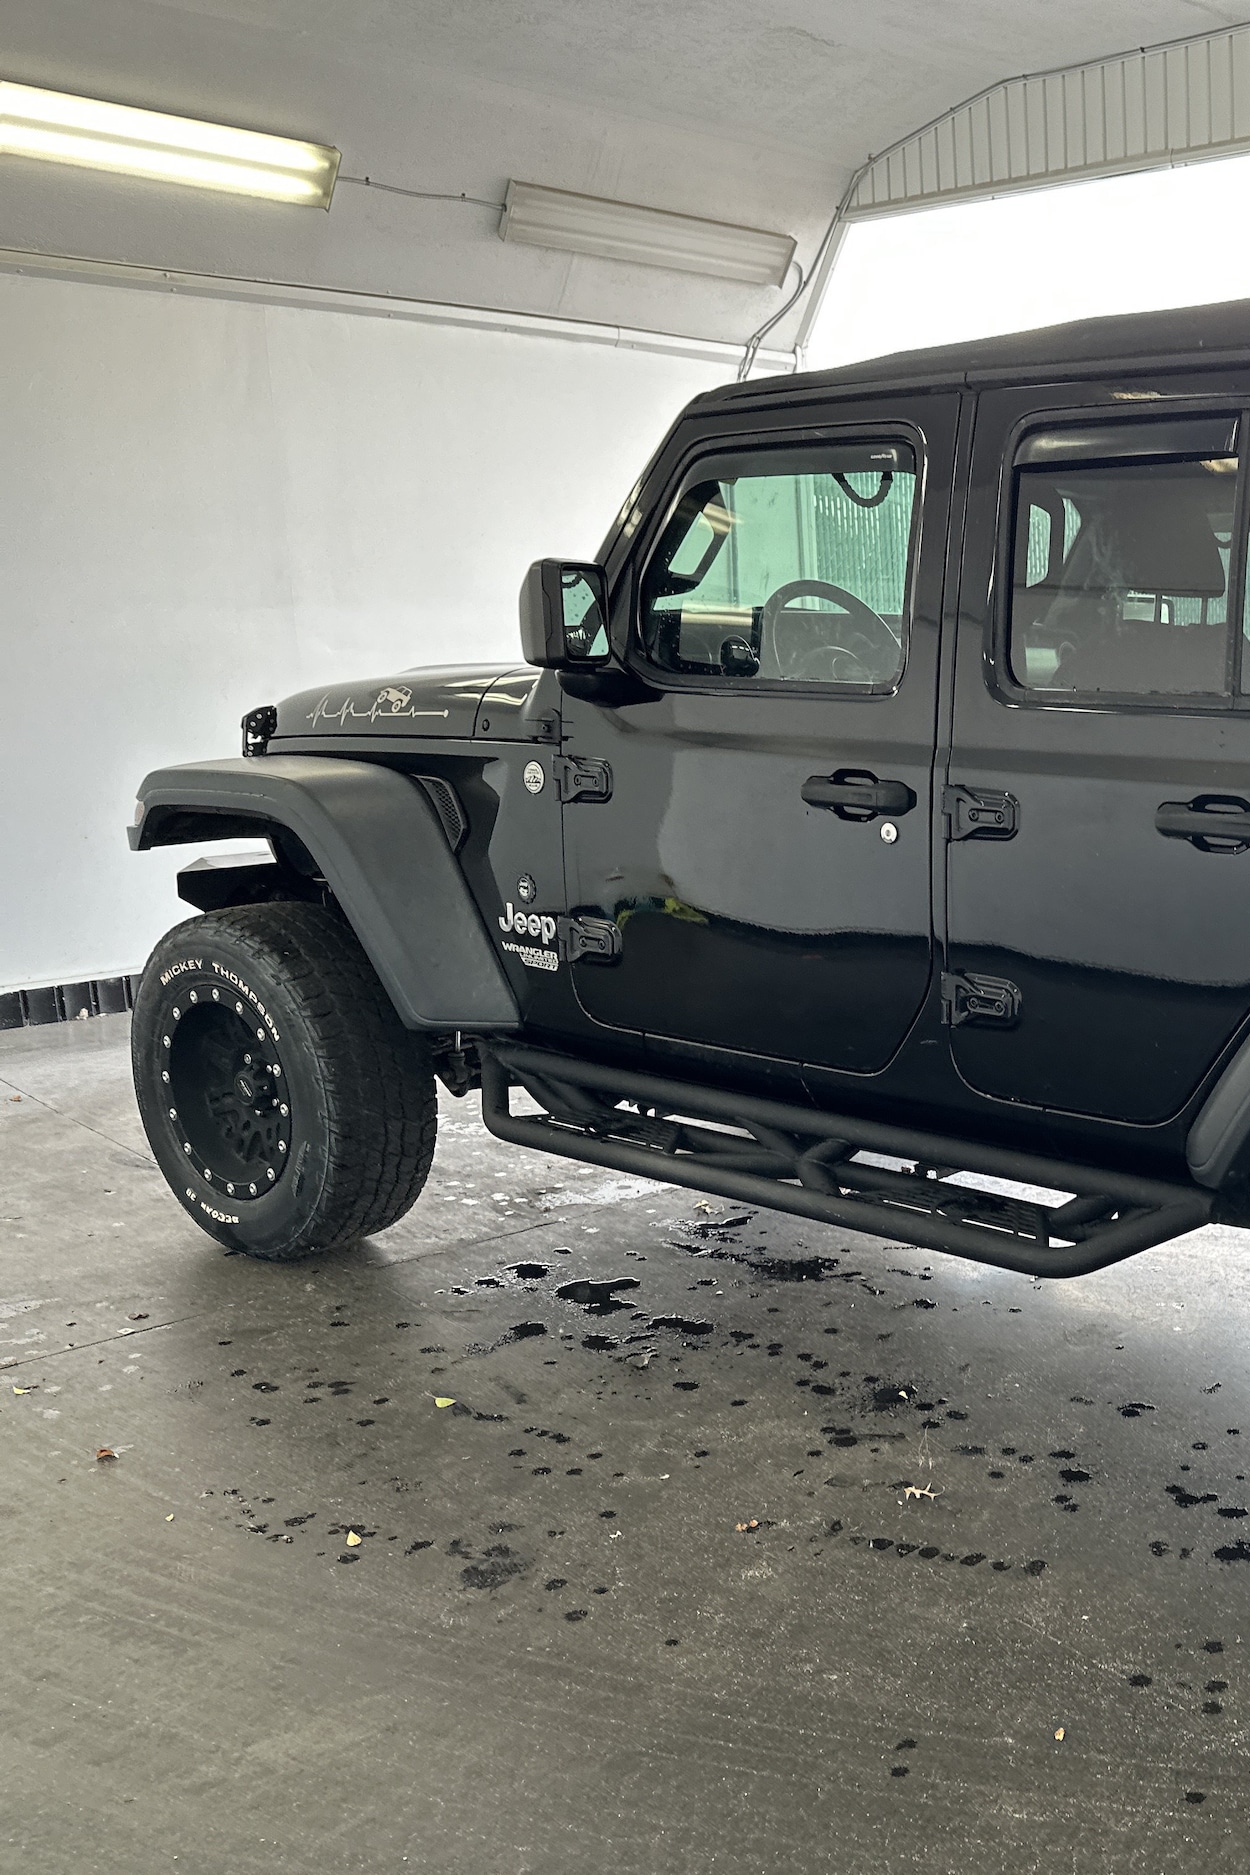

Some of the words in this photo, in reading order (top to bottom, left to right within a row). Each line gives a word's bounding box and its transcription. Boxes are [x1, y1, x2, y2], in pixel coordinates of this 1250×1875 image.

[498, 902, 556, 944] Jeep
[501, 941, 558, 960] WRANGLER
[524, 959, 556, 970] SPORT
[160, 959, 203, 986] MICKEY
[212, 962, 280, 1042] THOMPSON
